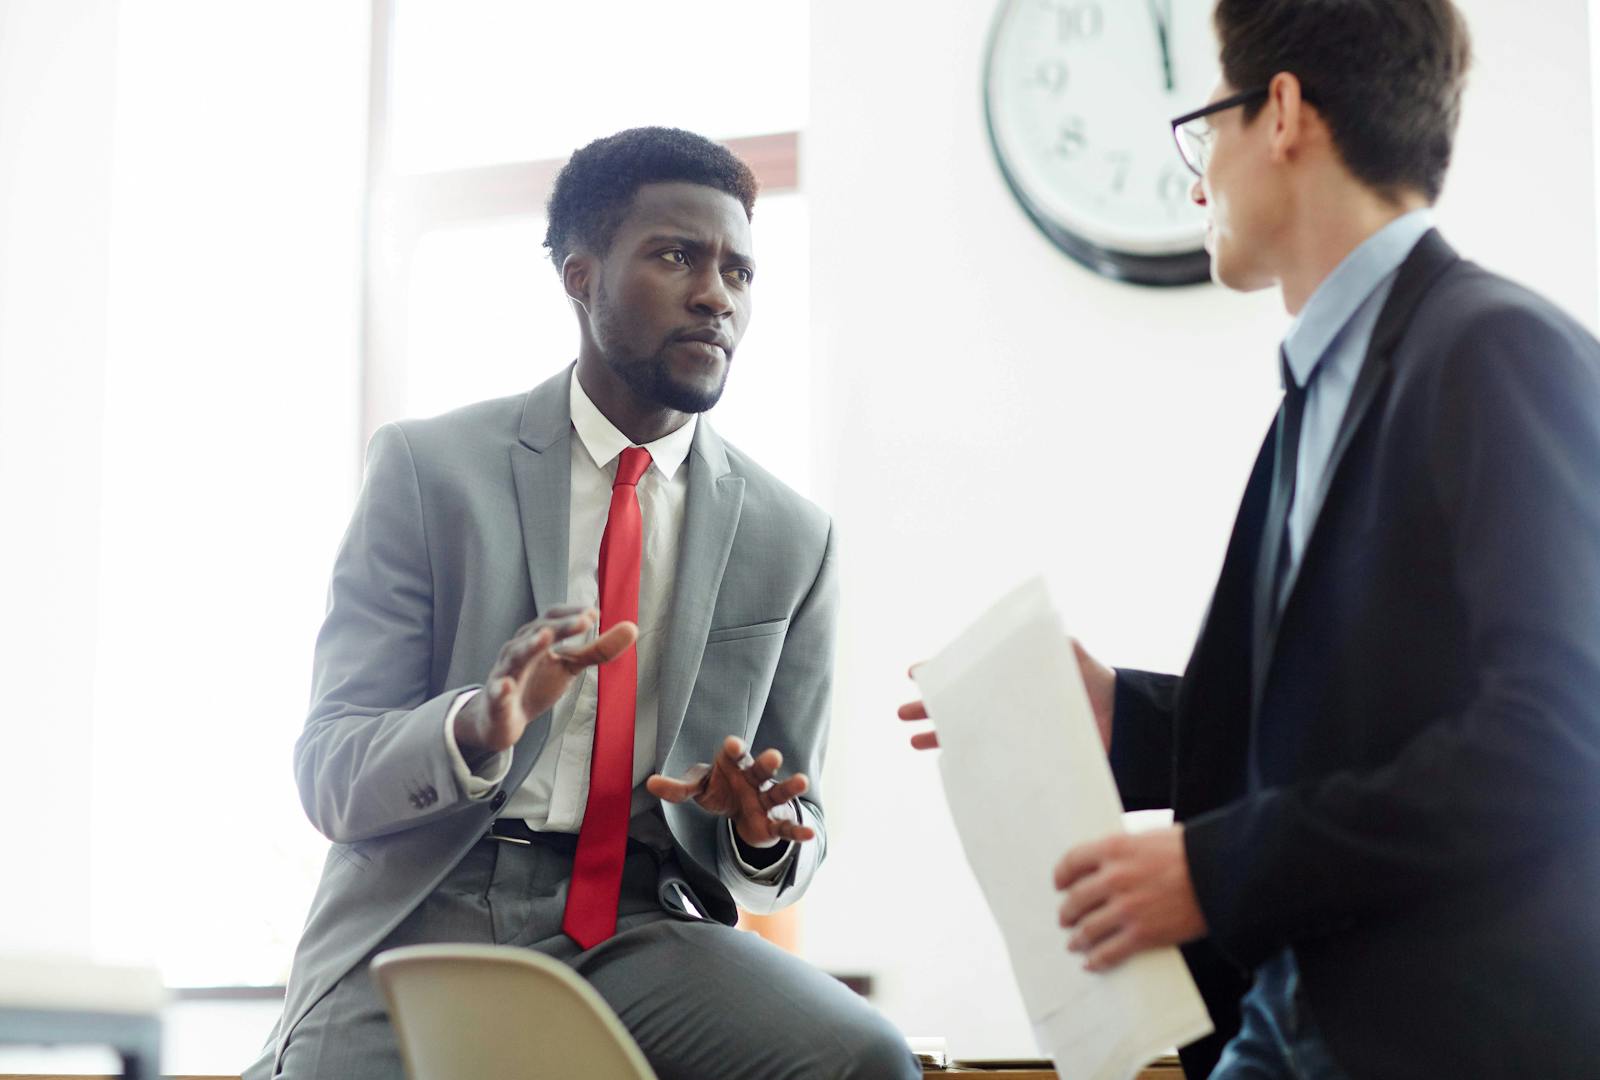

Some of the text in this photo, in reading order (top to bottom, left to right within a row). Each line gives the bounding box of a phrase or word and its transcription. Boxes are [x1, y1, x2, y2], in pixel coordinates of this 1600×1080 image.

[1056, 4, 1104, 43] 10
[1034, 58, 1071, 96] 9
[1054, 115, 1088, 160] 8
[1103, 149, 1134, 195] 7
